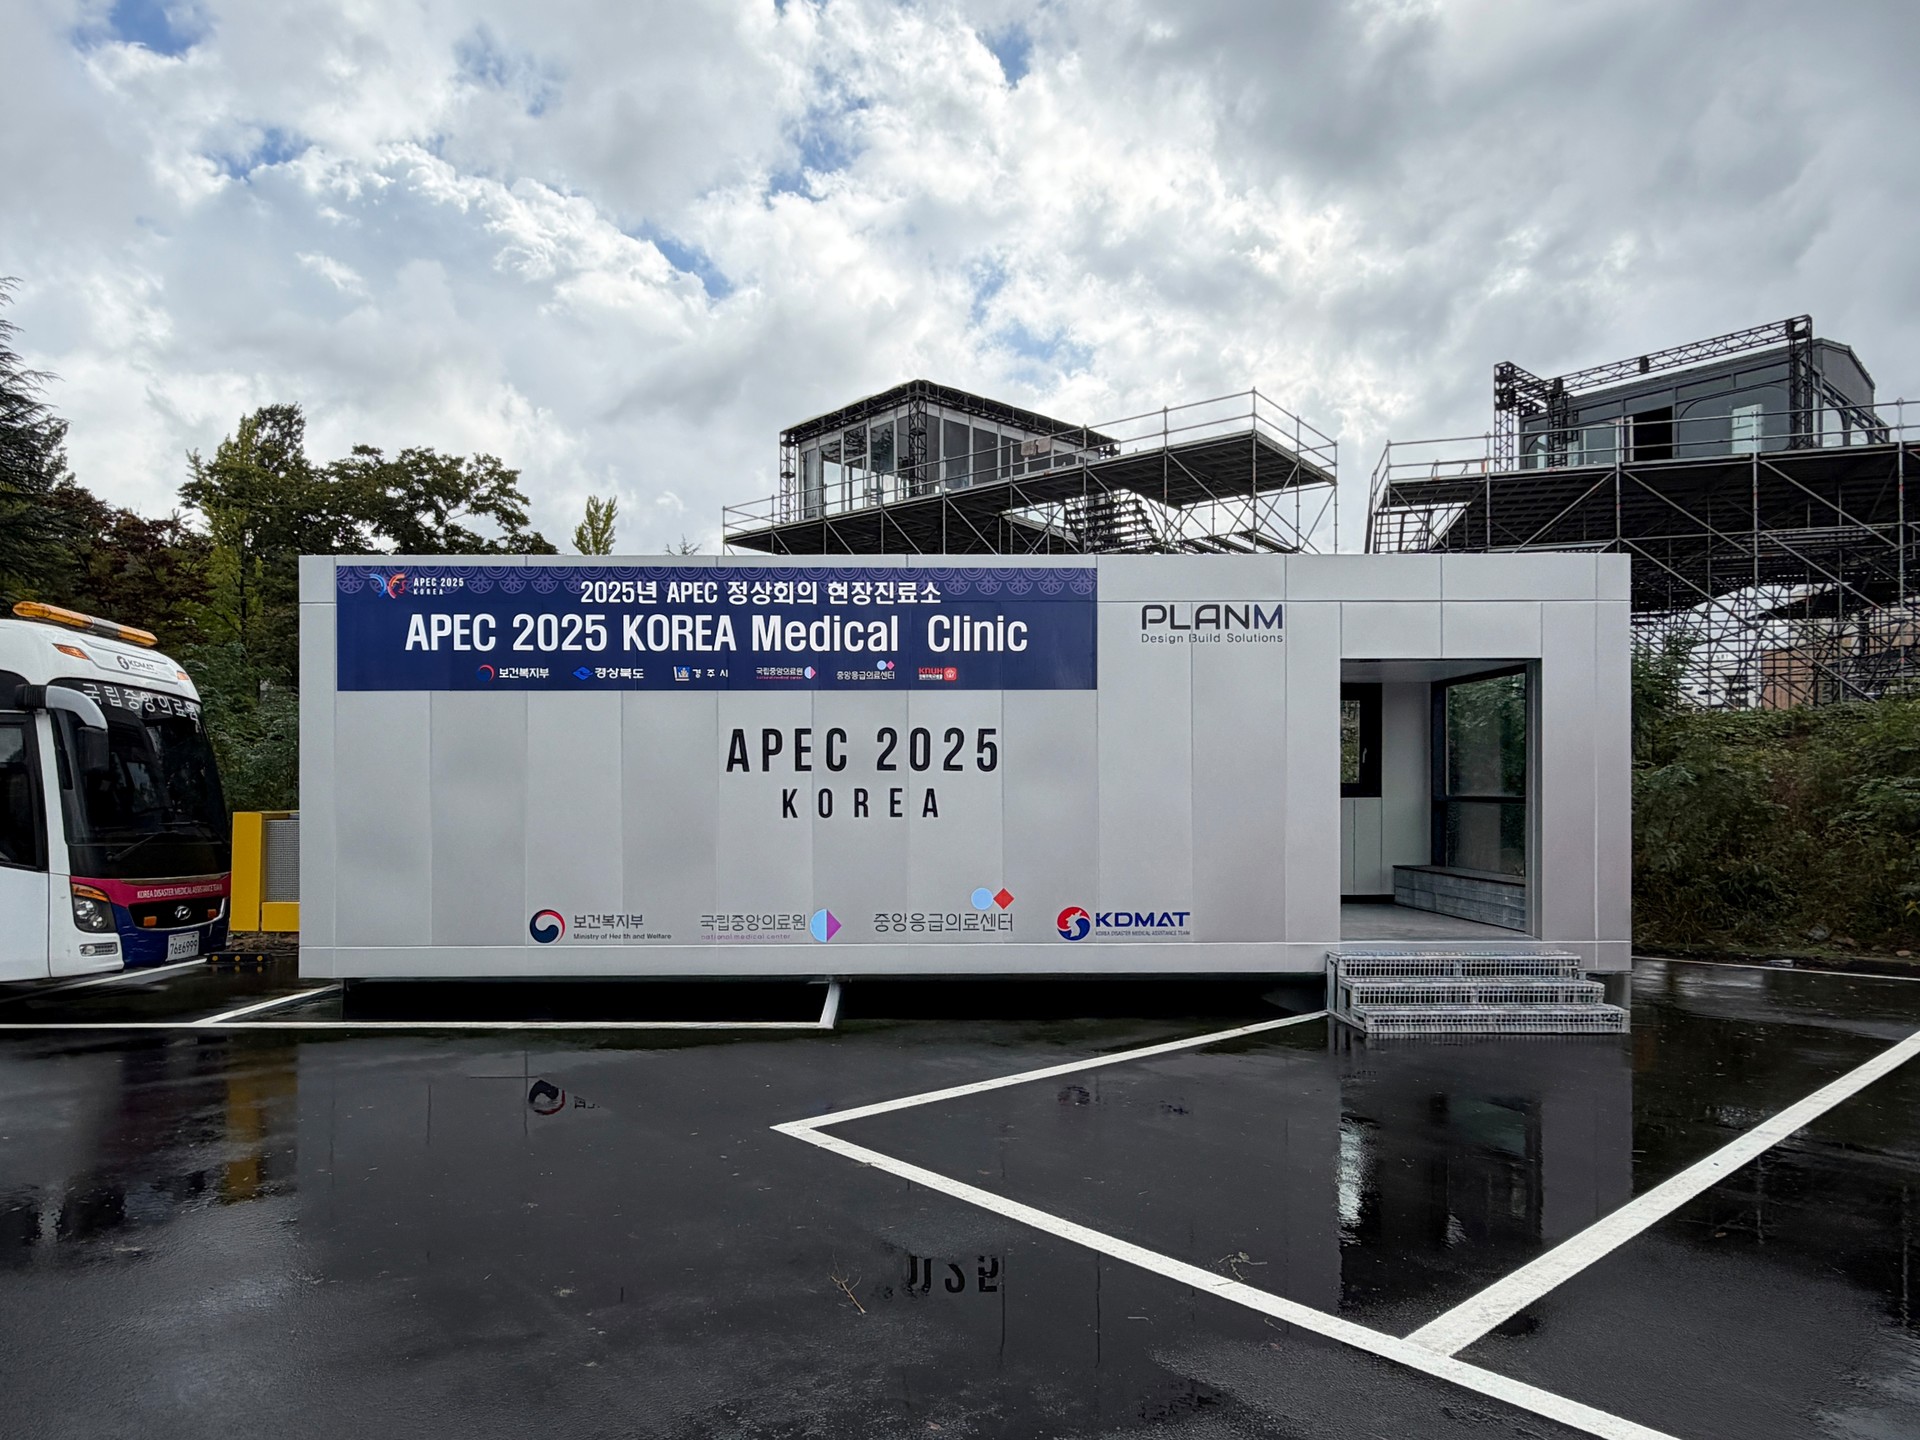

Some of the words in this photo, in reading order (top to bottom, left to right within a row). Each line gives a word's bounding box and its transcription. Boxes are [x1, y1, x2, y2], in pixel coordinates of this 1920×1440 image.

[413, 577, 437, 587] APEC
[440, 577, 464, 587] 2025
[580, 580, 657, 605] 2025년
[666, 581, 718, 603] APEC
[727, 581, 818, 605] 정상회의
[827, 581, 941, 605] 현장진료소
[1142, 604, 1283, 629] PLANM
[405, 613, 497, 652] APEC
[512, 613, 609, 652] 2025
[622, 613, 737, 652] KOREA
[751, 614, 898, 653] Medical
[927, 614, 1028, 653] Clinic
[1141, 633, 1184, 644] Design
[1189, 633, 1221, 643] Build
[1226, 633, 1283, 643] Solutions
[498, 667, 550, 679] 보건복지부
[594, 667, 644, 680] 경상북도
[836, 671, 895, 681] 중앙응급의료센터
[726, 727, 848, 773] APEC
[876, 727, 998, 773] 2025
[782, 788, 939, 819] KOREA
[573, 914, 644, 930] 보건복지부
[701, 914, 806, 931] 국립중앙의료원
[873, 912, 1013, 931] 중앙응급의료센터
[1095, 911, 1191, 928] KDMAT
